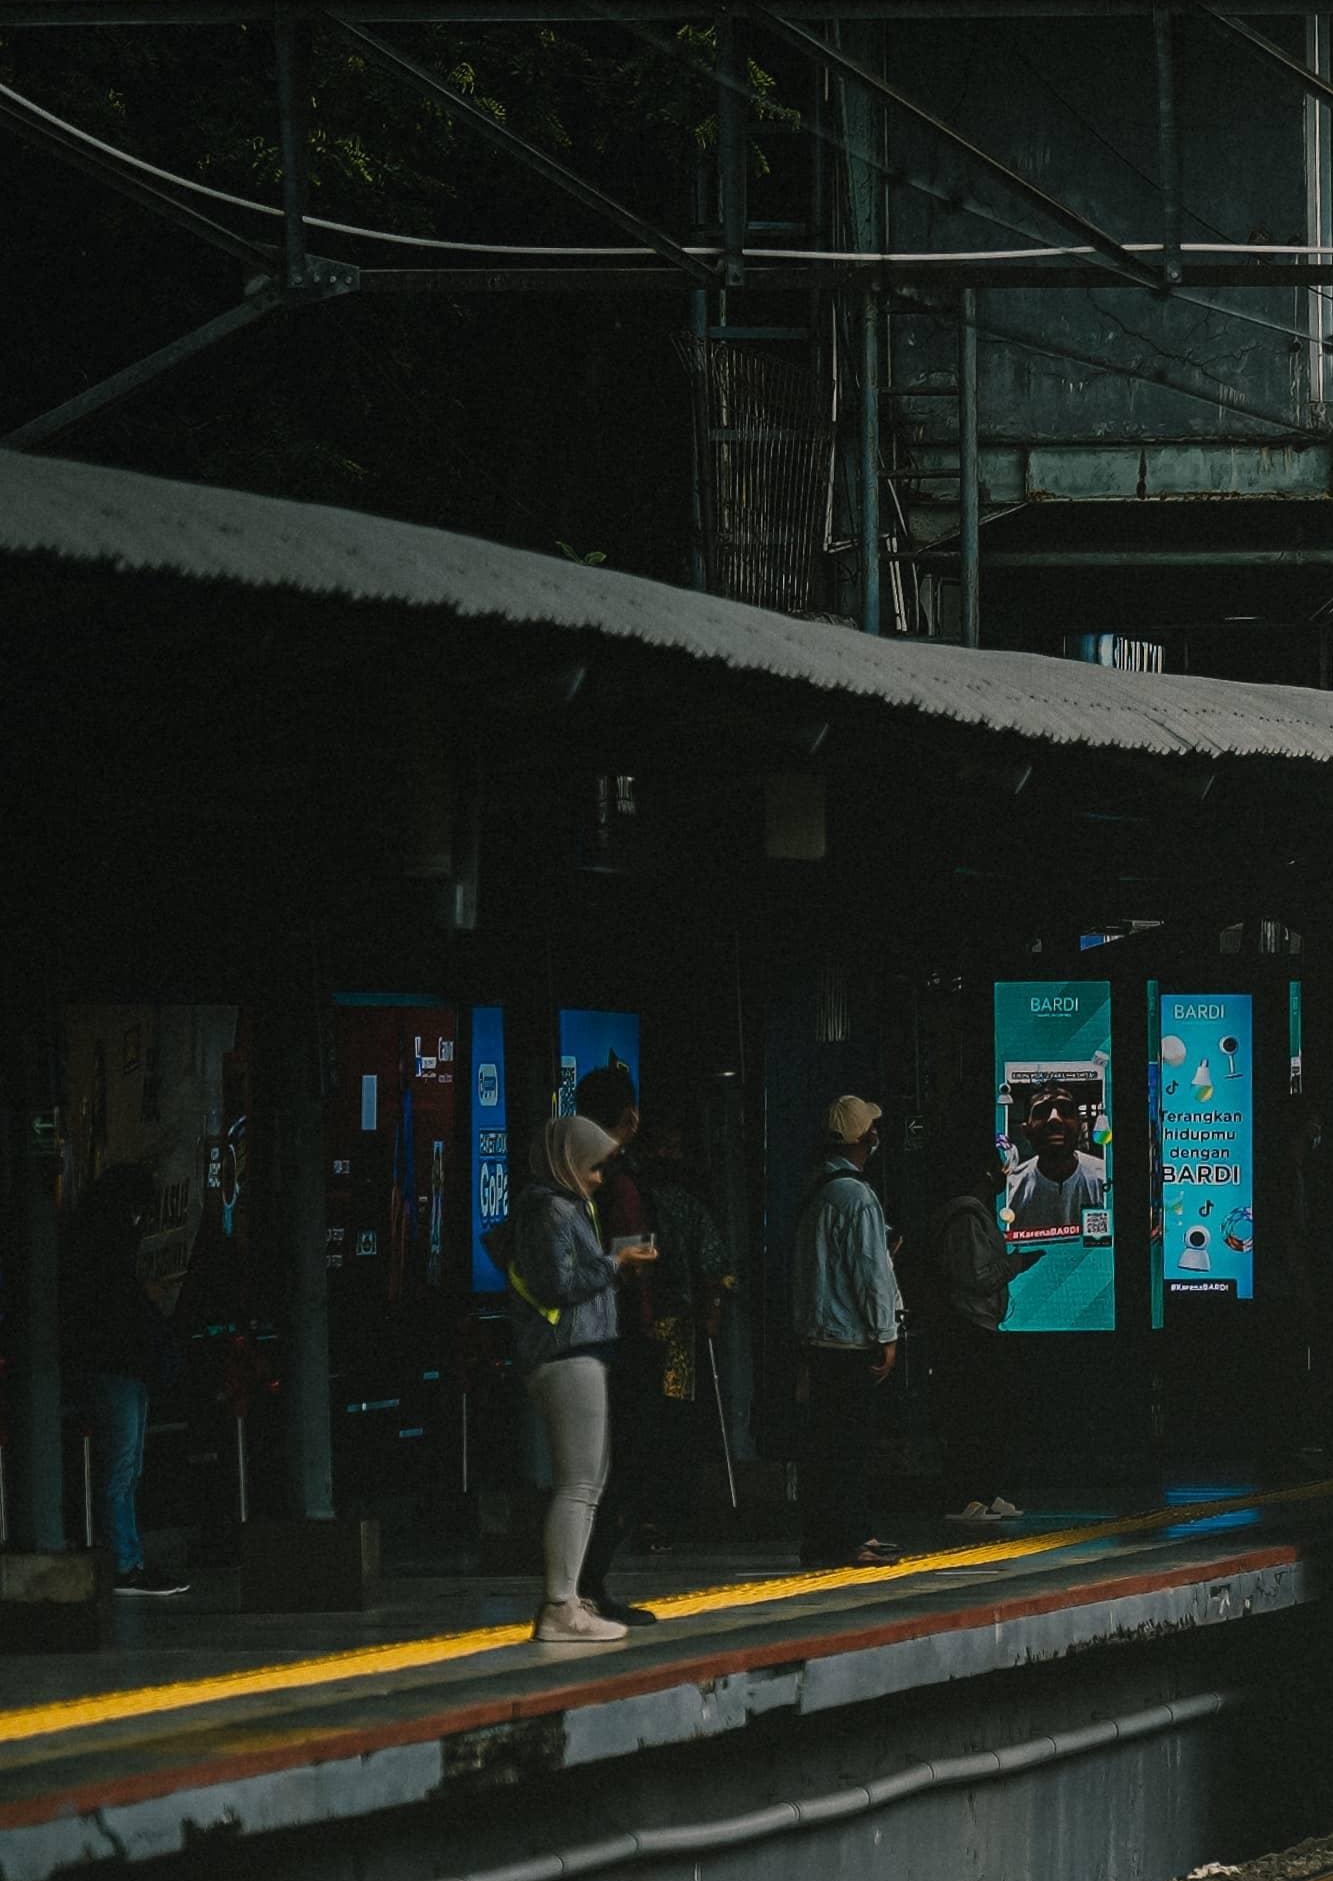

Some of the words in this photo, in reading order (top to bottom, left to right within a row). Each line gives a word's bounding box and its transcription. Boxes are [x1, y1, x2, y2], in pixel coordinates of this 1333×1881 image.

[1030, 996, 1078, 1013] BARDI
[1174, 1003, 1224, 1020] BARDI
[1160, 1109, 1242, 1124] Terangkan
[1164, 1128, 1235, 1142] hidupmu
[1169, 1147, 1230, 1160] dengan
[1161, 1165, 1238, 1183] BARDI
